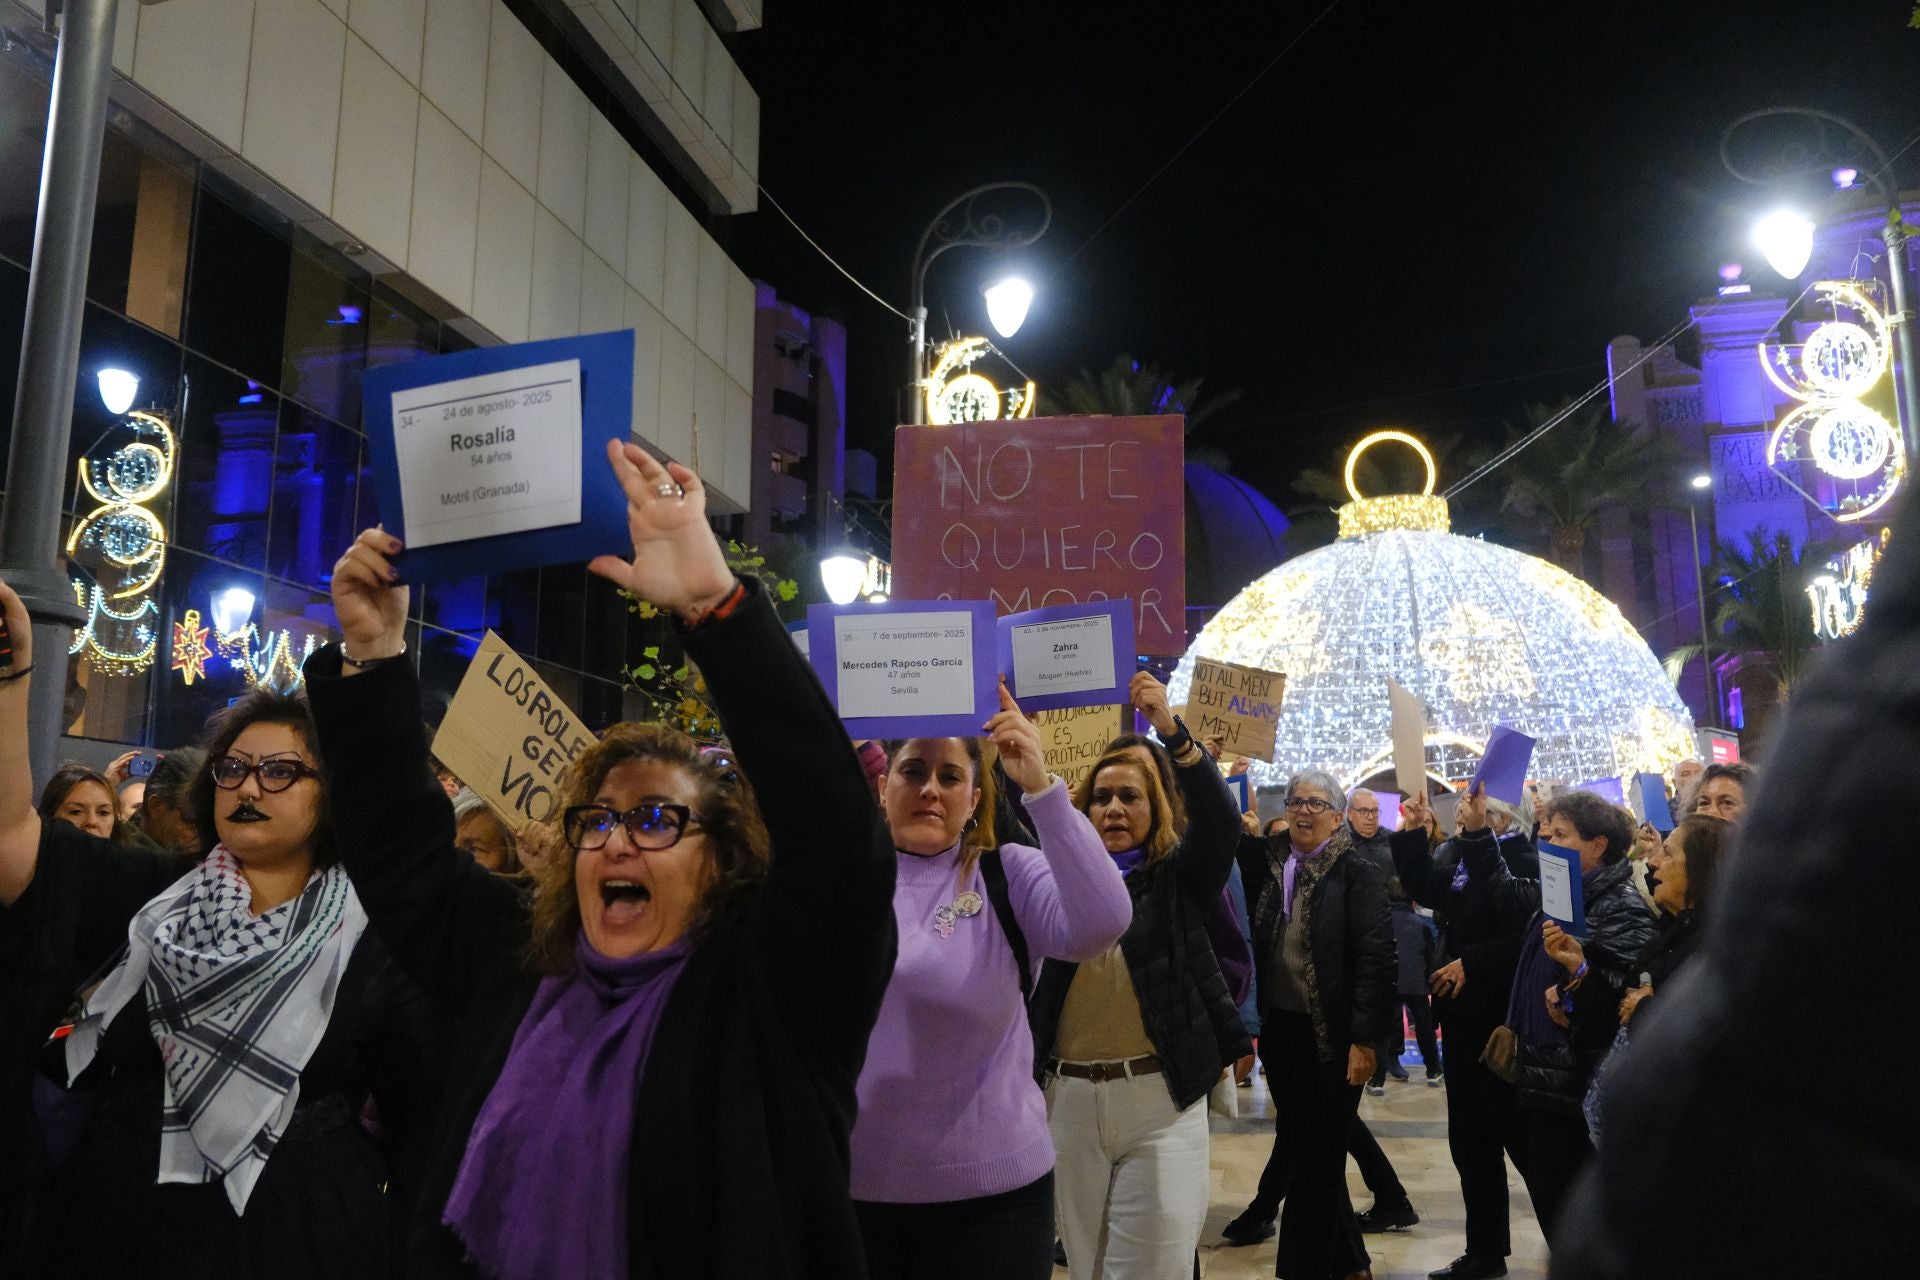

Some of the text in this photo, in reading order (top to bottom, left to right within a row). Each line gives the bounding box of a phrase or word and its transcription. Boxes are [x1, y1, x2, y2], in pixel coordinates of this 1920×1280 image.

[442, 406, 457, 421] 24
[460, 404, 475, 417] de
[477, 397, 520, 416] agosto-
[522, 390, 553, 406] 2025
[450, 424, 516, 452] Rosalía
[471, 451, 513, 467] 54 años
[941, 440, 1141, 508] NO TE
[440, 479, 530, 506] Motril (Granada)
[941, 522, 1163, 572] QUIERO
[872, 632, 878, 640] 7
[879, 631, 890, 640] de
[944, 629, 965, 638] 2025
[1083, 619, 1099, 627] 2025
[1052, 643, 1079, 653] Zahra
[842, 657, 963, 670] Mercedes Raposo García
[887, 670, 921, 679] 47 años
[1038, 669, 1092, 681] Moguer (Huelva)
[890, 686, 919, 695] Sevilla
[1193, 663, 1271, 698] NOT ALL MEN
[486, 653, 588, 762] LOS ROLE
[1227, 694, 1278, 723] ALWAYS
[1053, 726, 1073, 746] ES
[1198, 712, 1241, 744] MEN
[1042, 727, 1109, 766] XPLOTACIÓN
